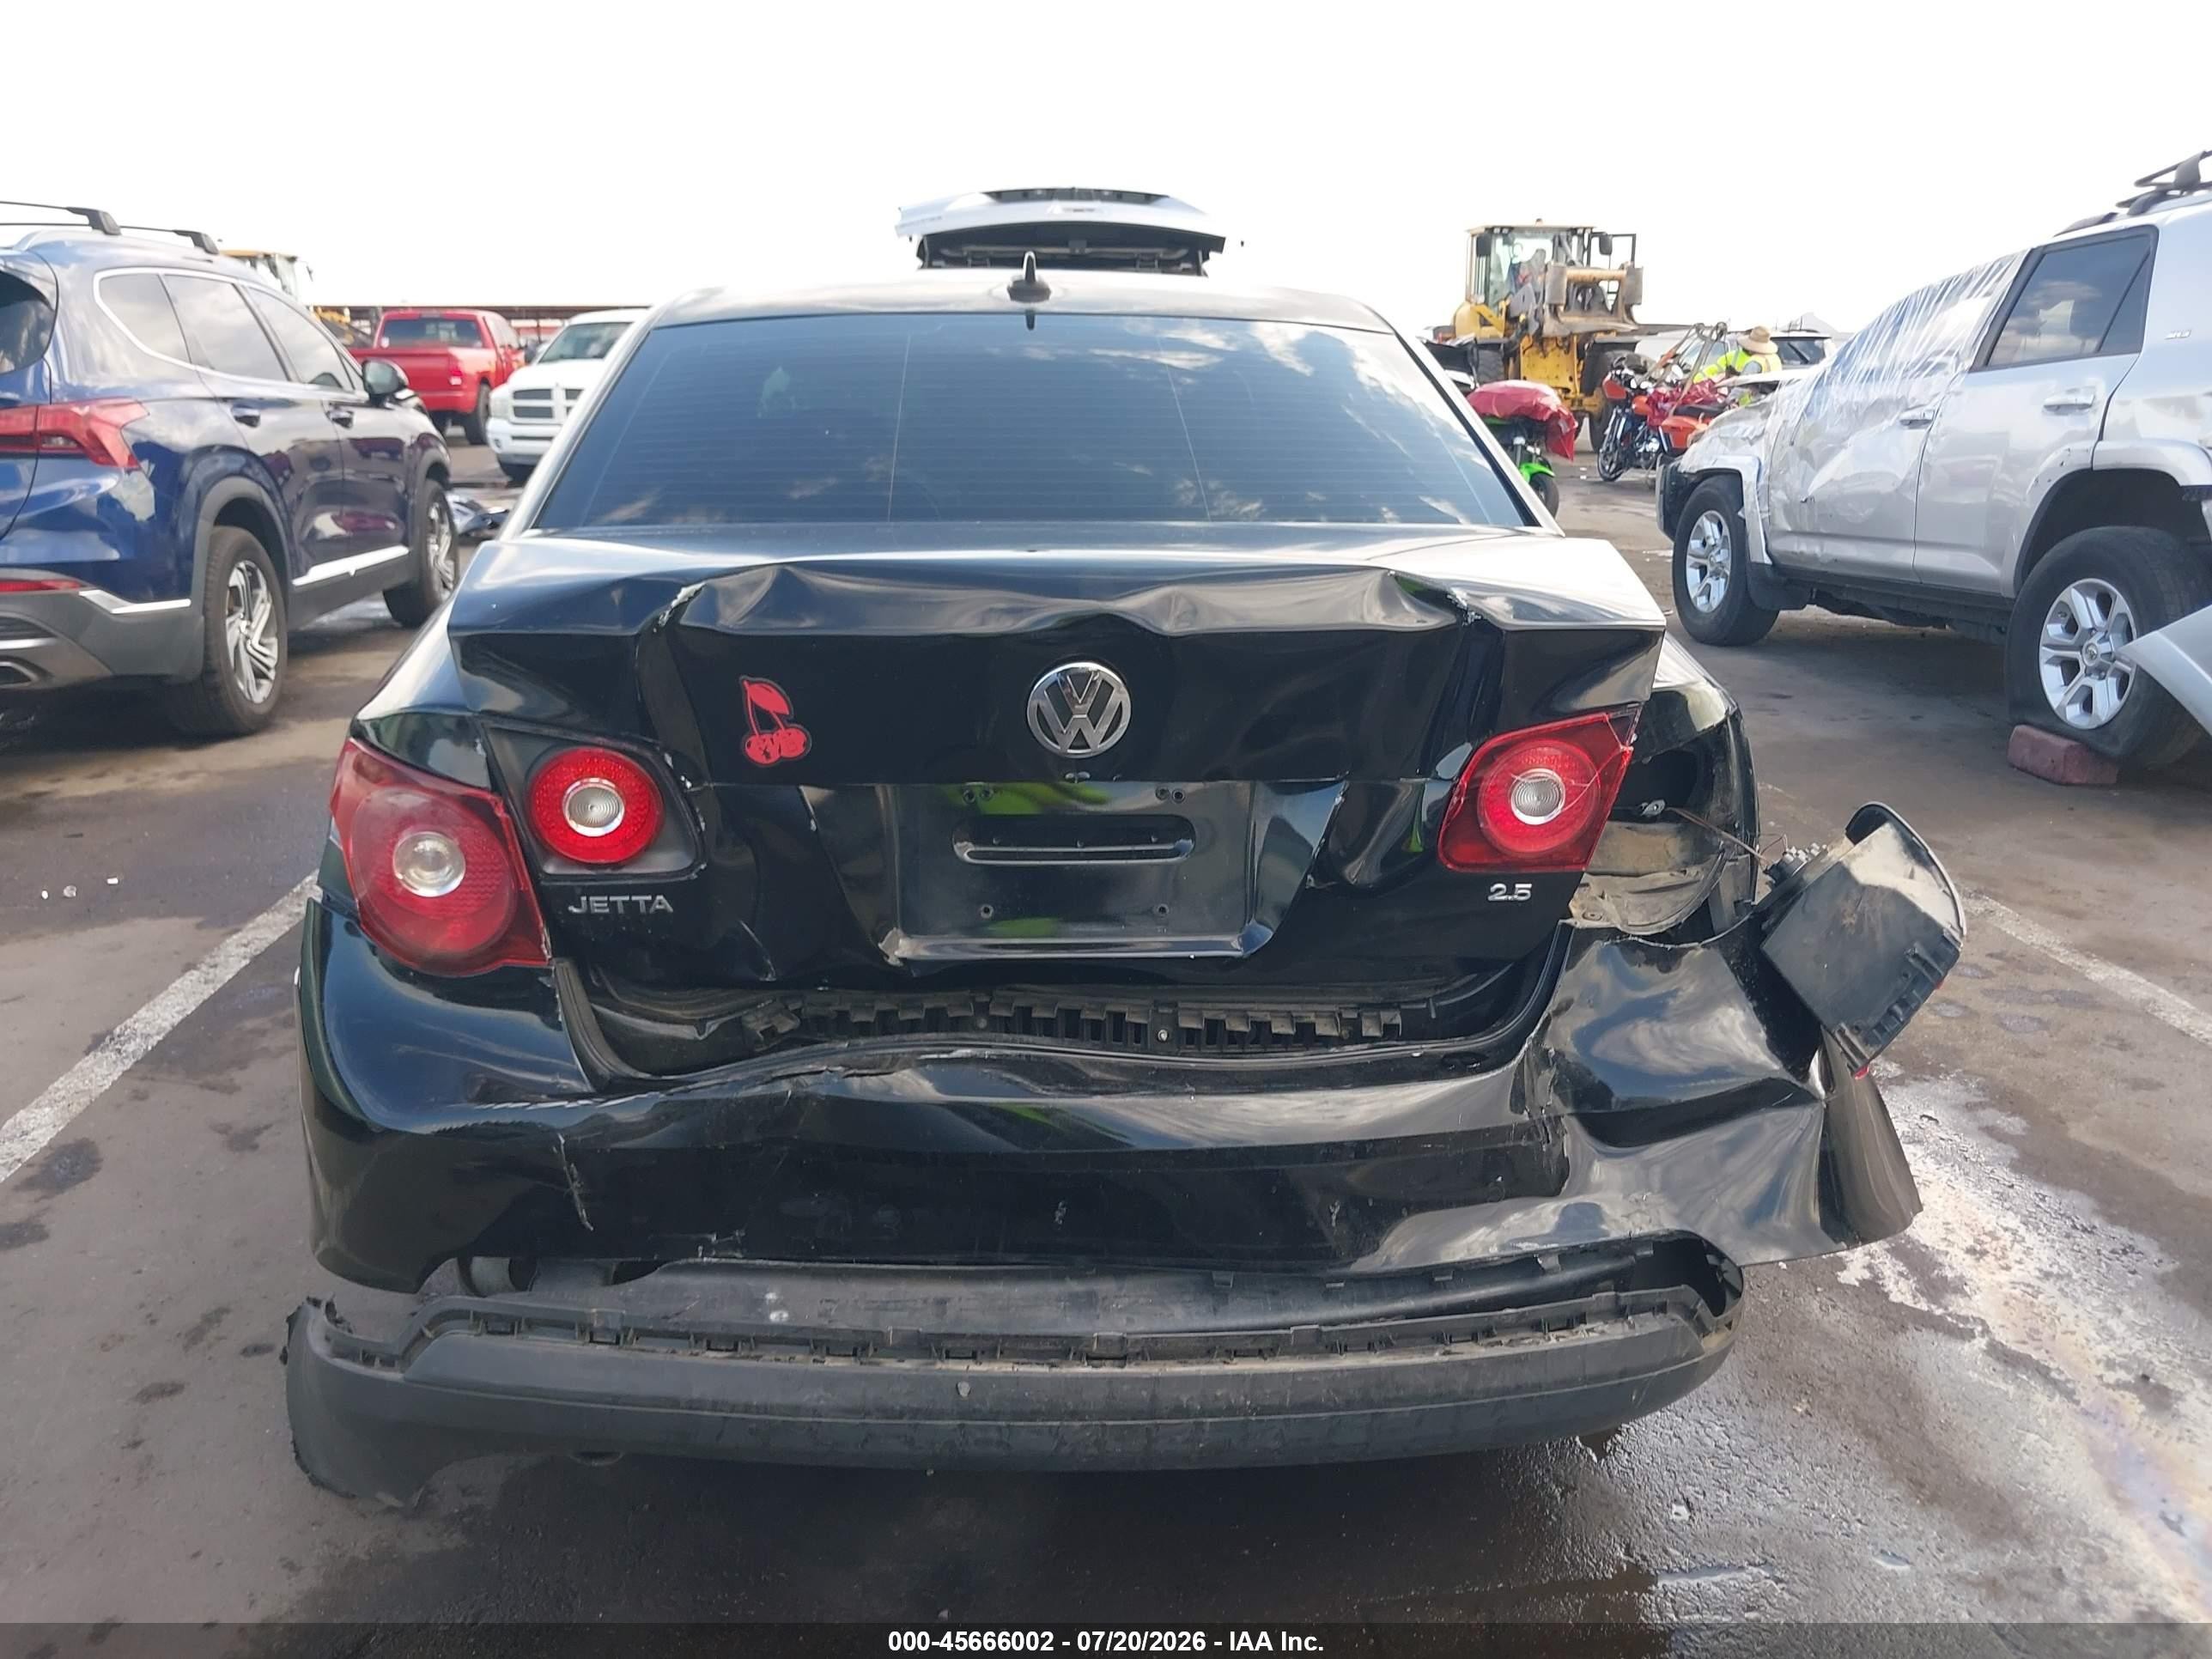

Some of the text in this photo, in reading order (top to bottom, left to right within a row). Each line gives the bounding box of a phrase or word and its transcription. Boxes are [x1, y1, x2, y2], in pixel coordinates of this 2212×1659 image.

[1028, 663, 1130, 757] VW
[1487, 883, 1532, 902] 2.5
[568, 895, 674, 915] JETTA
